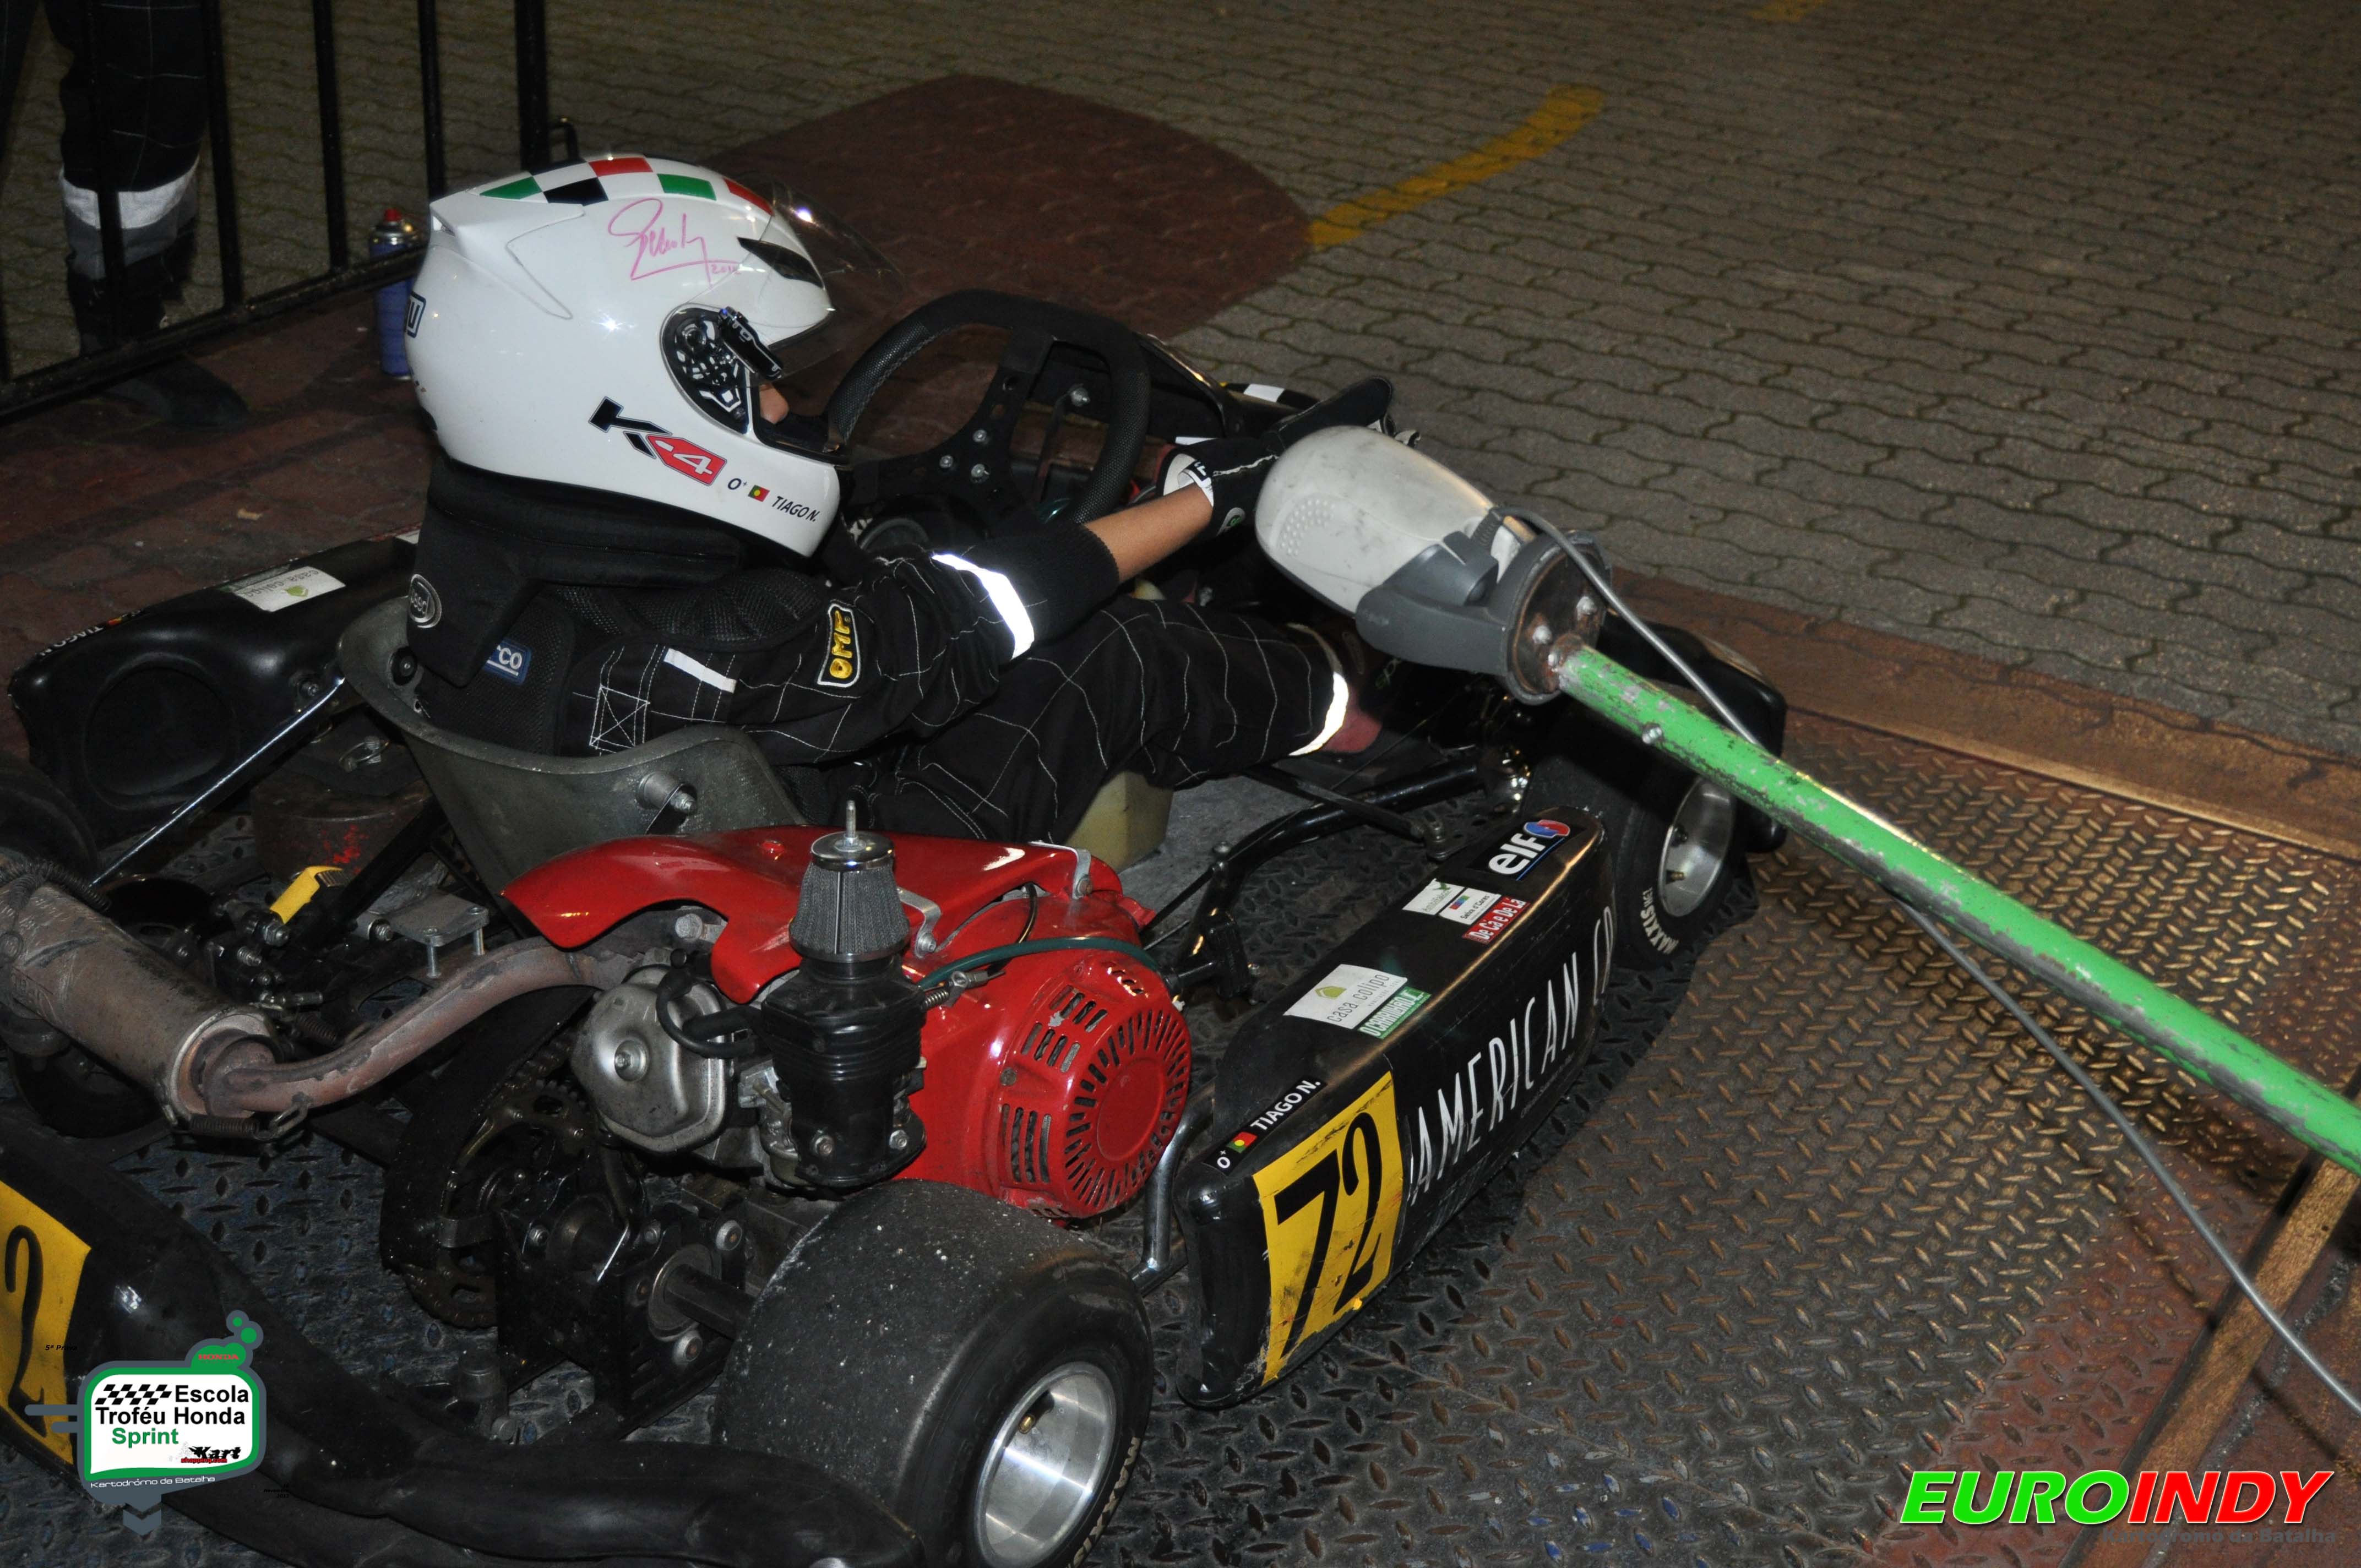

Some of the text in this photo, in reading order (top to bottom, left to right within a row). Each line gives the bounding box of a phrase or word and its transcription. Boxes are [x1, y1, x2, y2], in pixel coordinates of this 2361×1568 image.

[771, 496, 821, 522] TIAGO N.
[829, 610, 852, 679] OMP
[1489, 833, 1546, 874] elf
[1327, 1001, 1358, 1022] casa
[1353, 974, 1389, 1000] colipo
[1410, 951, 1579, 1206] AMERICAN
[1250, 1080, 1321, 1130] TIAGO N.
[1274, 1113, 1383, 1360] 72
